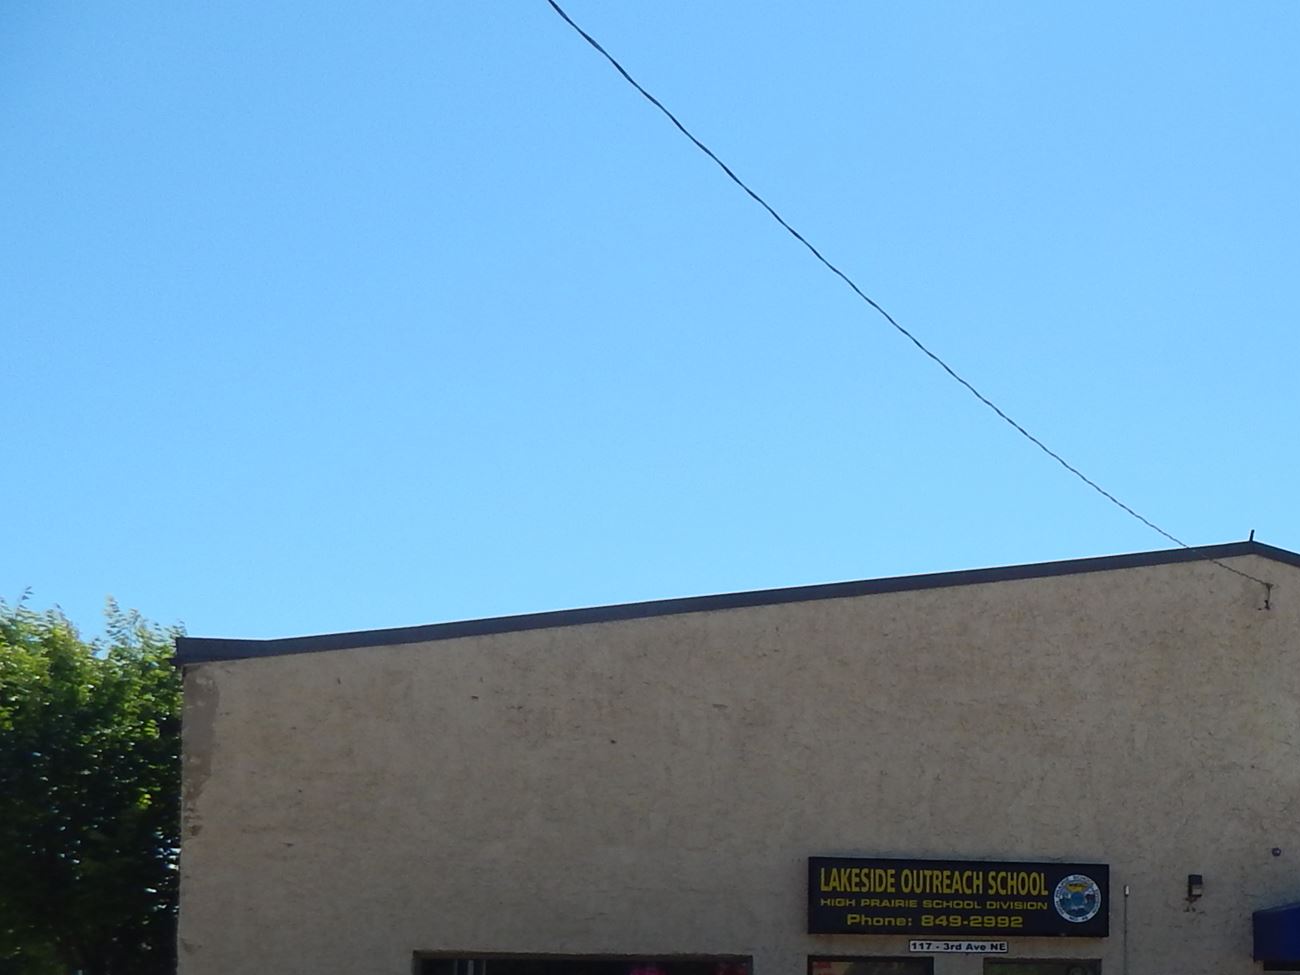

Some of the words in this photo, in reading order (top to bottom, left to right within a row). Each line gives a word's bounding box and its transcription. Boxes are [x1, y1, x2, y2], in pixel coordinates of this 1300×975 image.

[820, 867, 896, 893] LAKESIDE
[900, 869, 983, 895] OUTREACH
[988, 871, 1049, 896] SCHOOL
[820, 898, 855, 907] HIGH
[860, 899, 918, 908] PRAIRIE
[922, 900, 981, 909] SCHOOL
[986, 901, 1048, 910] DIVISION
[847, 914, 913, 926] Phone:
[921, 915, 1023, 928] 849-2992
[966, 943, 986, 951] Ave
[990, 943, 1006, 951] NE
